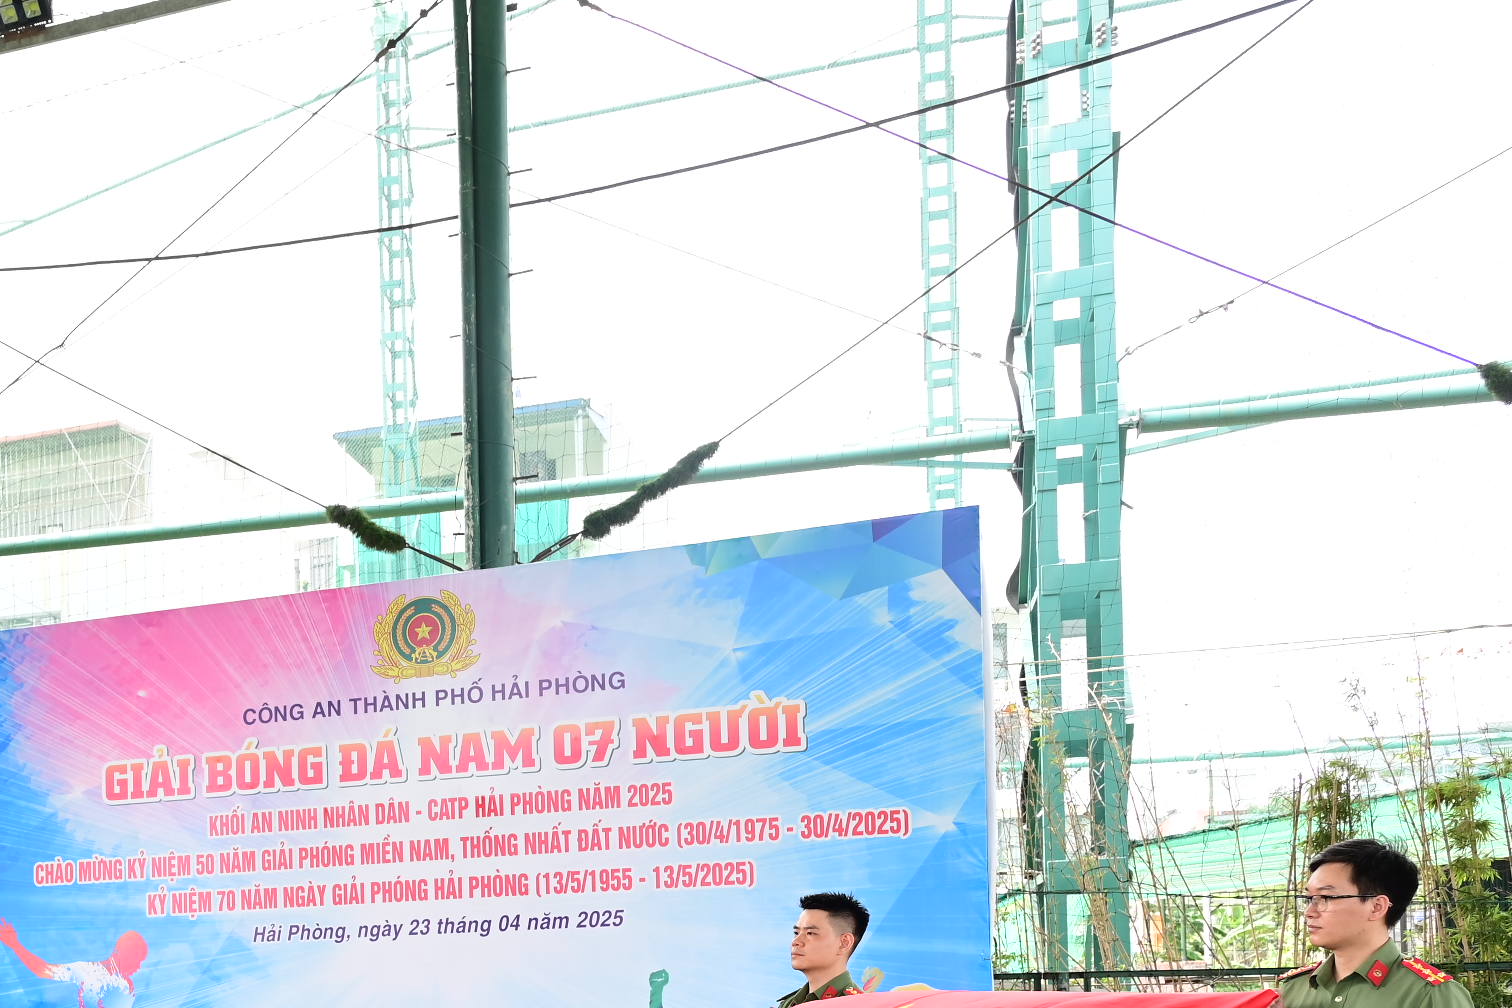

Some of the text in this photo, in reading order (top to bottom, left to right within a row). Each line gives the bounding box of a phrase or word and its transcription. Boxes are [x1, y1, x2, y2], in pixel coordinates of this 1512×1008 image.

[243, 670, 626, 726] CÔNG AN THÀNH PHỐ HẢI PHÒNG
[104, 693, 803, 803] GIẢI BÓNG ĐÁ NAM 07 NGƯỜI
[208, 805, 246, 837] KHỐI
[250, 811, 273, 834] AN
[277, 807, 319, 832] NINH
[323, 800, 370, 829] NHÂN
[375, 797, 410, 825] DÂN
[427, 796, 469, 822] CATP
[474, 786, 504, 819] HẢI
[509, 785, 572, 816] PHÒNG
[577, 781, 622, 812] NĂM
[627, 781, 673, 808] 2025
[34, 858, 75, 885] CHÀO
[77, 856, 123, 884] MỪNG
[127, 850, 147, 880] KỶ
[151, 851, 191, 882] NIỆM
[195, 853, 215, 876] 50
[219, 846, 256, 874] NĂM
[261, 840, 294, 872] GIẢI
[298, 840, 355, 870] PHÓNG
[359, 833, 404, 866] MIỀN
[409, 837, 455, 863] NAM,
[459, 826, 519, 860] THỐNG
[524, 821, 572, 856] NHẤT
[576, 818, 613, 853] ĐẤT
[618, 819, 670, 850] NƯỚC
[676, 816, 780, 849] (30/4/1975
[800, 808, 910, 840] 30/4/2025)
[147, 886, 168, 916] KỶ
[171, 887, 212, 918] NIỆM
[216, 889, 236, 912] 70
[240, 883, 278, 911] NĂM
[282, 880, 327, 909] NGÀY
[331, 874, 365, 906] GIẢI
[370, 875, 429, 904] PHÓNG
[433, 869, 463, 901] HẢI
[468, 868, 529, 899] PHÒNG
[535, 867, 633, 898] (13/5/1955
[652, 860, 755, 889] 13/5/2025)
[253, 909, 625, 944] Hải Phòng, ngày 23 tháng 04 năm 2025
